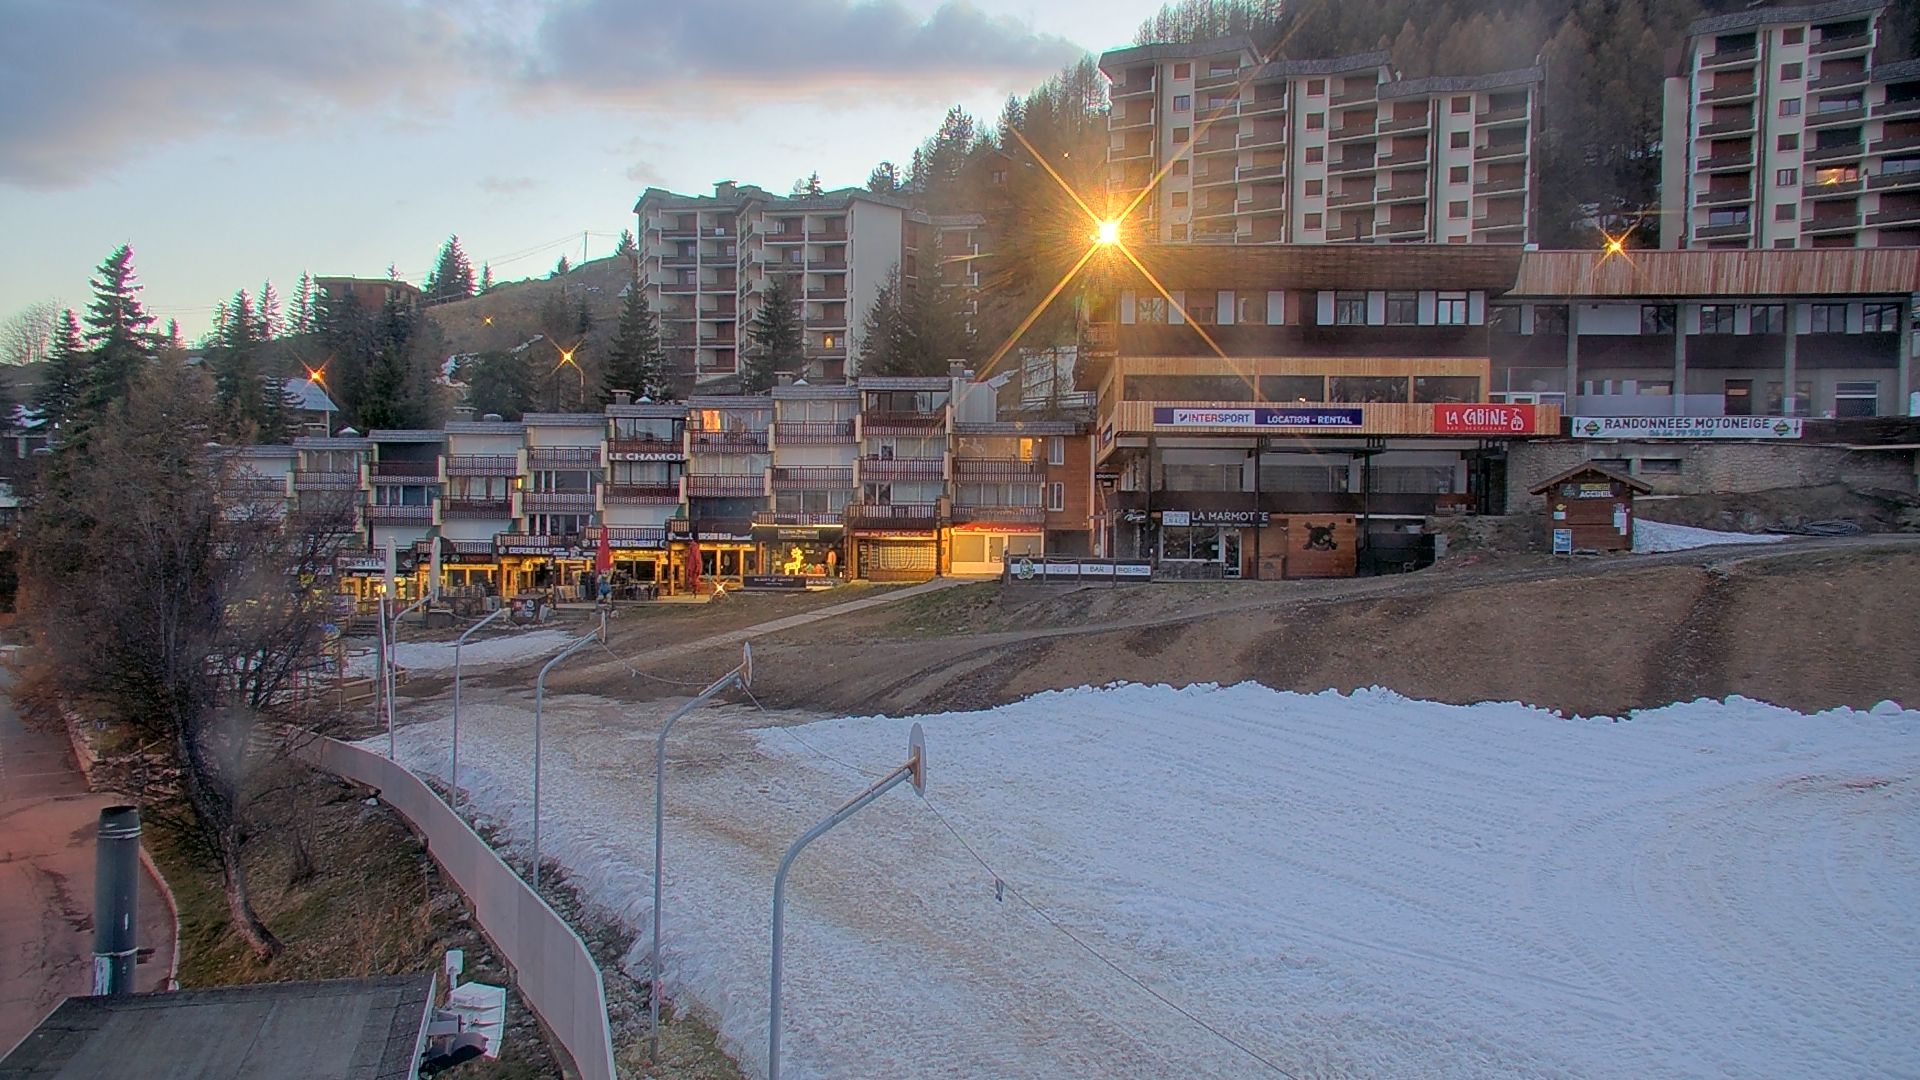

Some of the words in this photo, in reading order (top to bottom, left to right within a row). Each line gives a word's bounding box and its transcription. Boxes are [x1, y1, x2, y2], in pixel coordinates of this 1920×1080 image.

[1188, 413, 1250, 423] INTERSPORT
[1267, 415, 1310, 424] LOCATION
[1317, 415, 1353, 424] RENTAL
[1446, 411, 1458, 425] LA
[1604, 419, 1690, 429] RANDONNEES
[1695, 419, 1769, 429] MOTONEIGE
[608, 453, 622, 461] LE
[1191, 511, 1206, 521] LA
